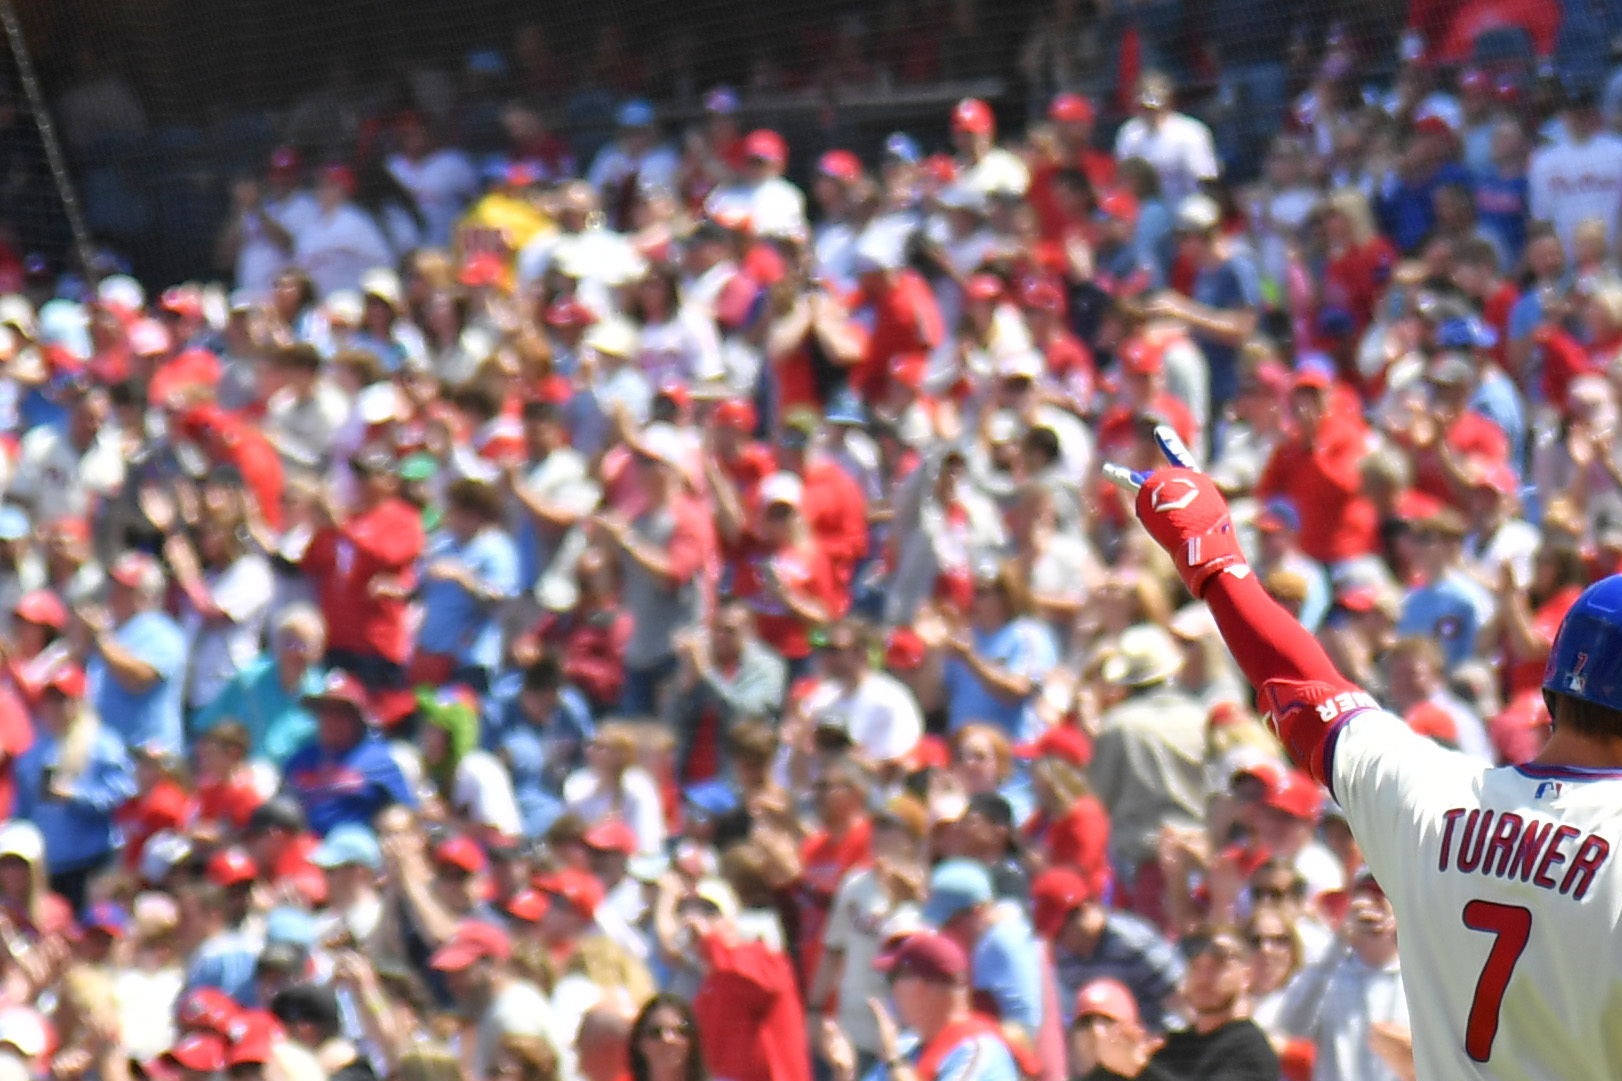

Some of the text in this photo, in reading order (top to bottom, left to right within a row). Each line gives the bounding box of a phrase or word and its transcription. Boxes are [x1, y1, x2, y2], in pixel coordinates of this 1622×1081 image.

[1574, 651, 1588, 675] 7
[1438, 807, 1611, 901] TURNER
[1462, 898, 1532, 1063] 7
